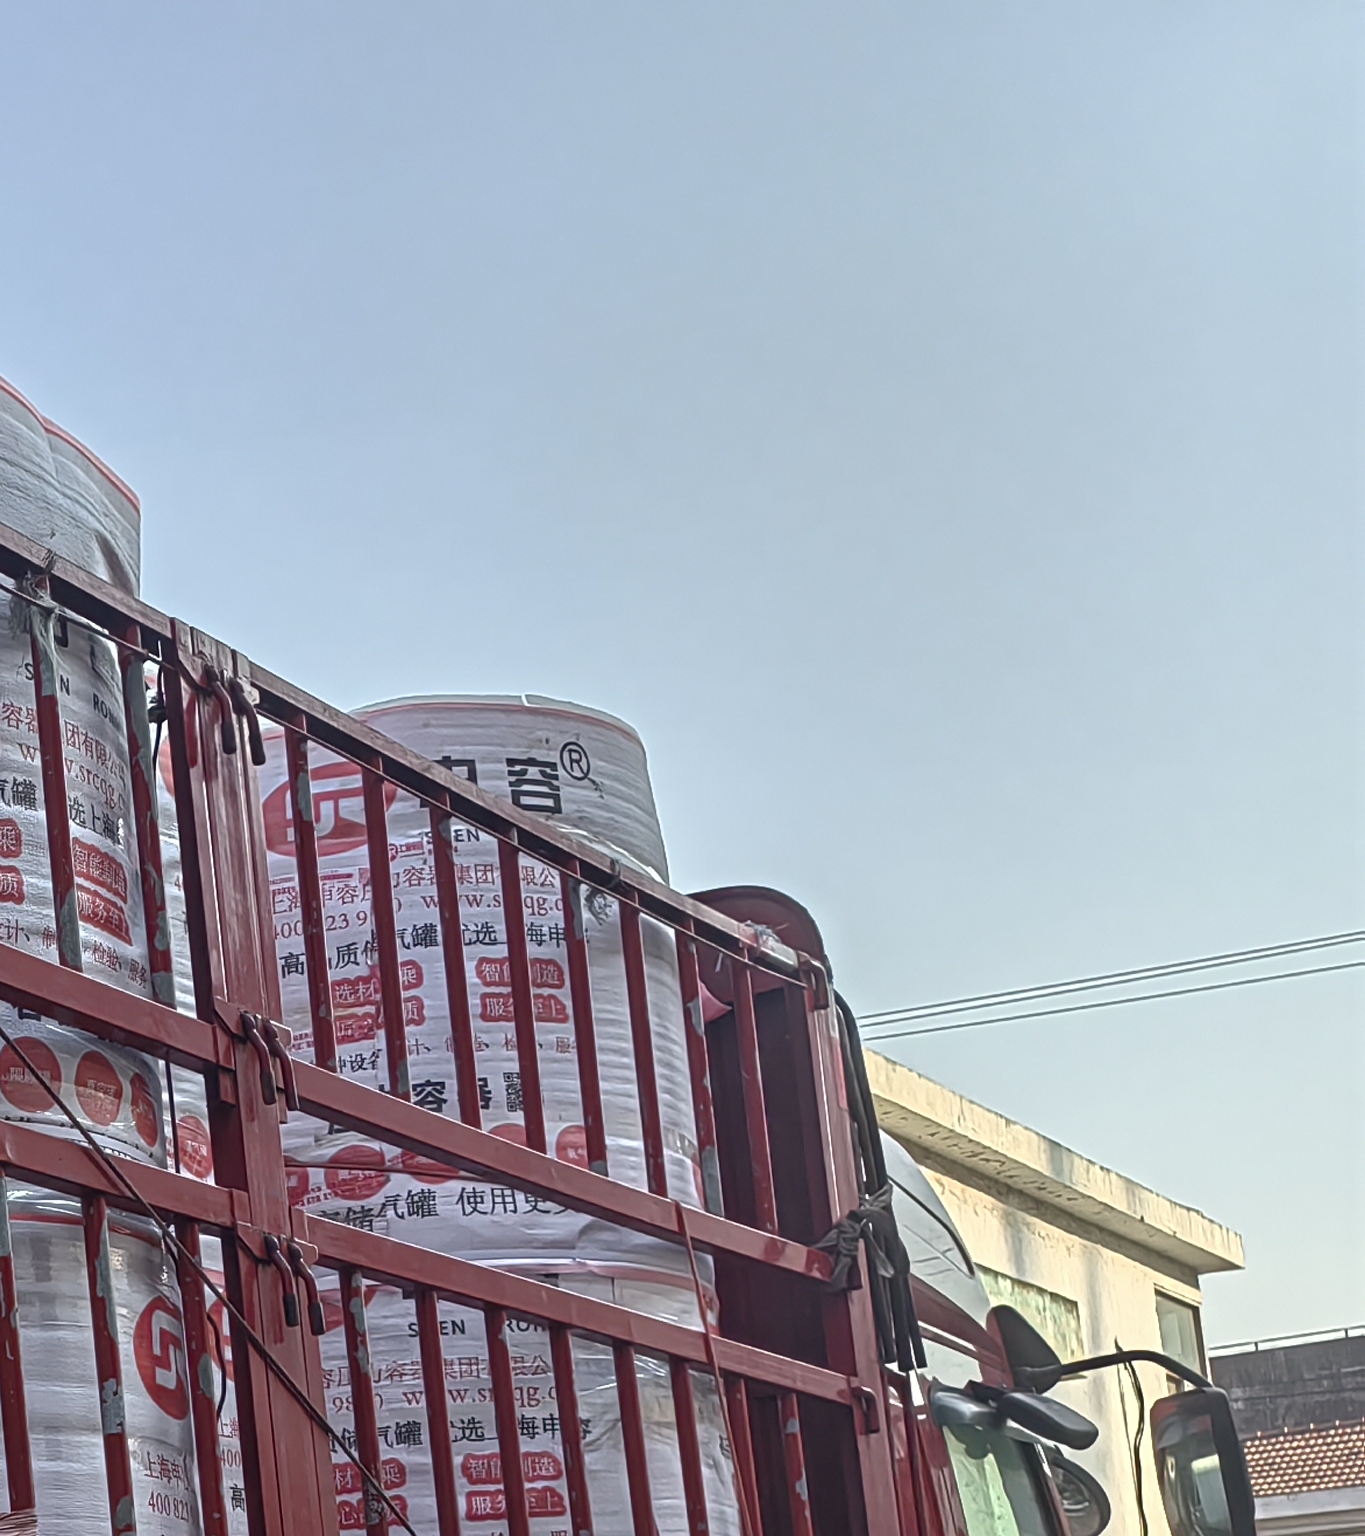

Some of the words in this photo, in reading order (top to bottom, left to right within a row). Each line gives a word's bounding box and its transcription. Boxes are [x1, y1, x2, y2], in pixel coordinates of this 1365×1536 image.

[424, 828, 481, 846] SEN
[334, 965, 418, 1003] 选材乘
[407, 1319, 467, 1338] SEN
